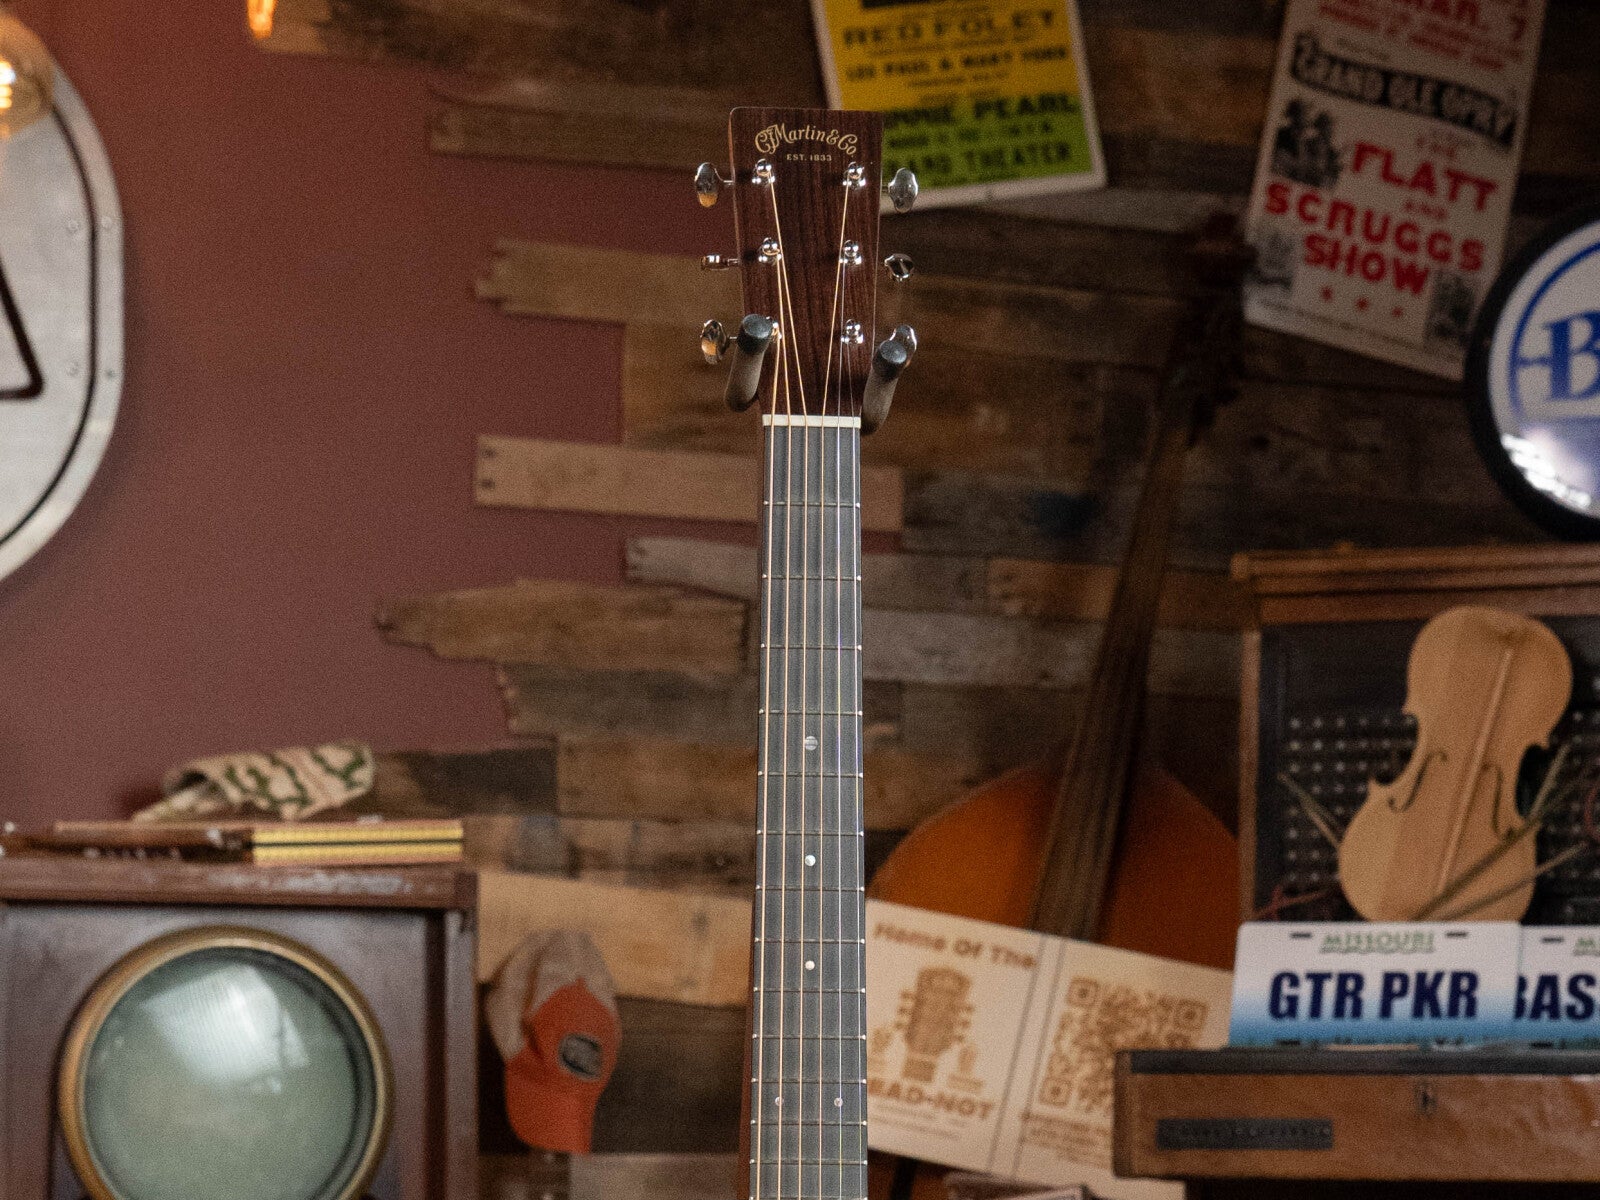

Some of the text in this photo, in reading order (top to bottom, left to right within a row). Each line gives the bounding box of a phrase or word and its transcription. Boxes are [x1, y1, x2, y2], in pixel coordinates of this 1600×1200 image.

[786, 153, 832, 162] EST. 1833
[1351, 141, 1498, 212] FLATT
[1264, 181, 1486, 273] SCRUGGS
[1303, 232, 1429, 297] SHOW
[1321, 931, 1436, 952] MISSOURI
[1267, 970, 1479, 1021] GTR PKR
